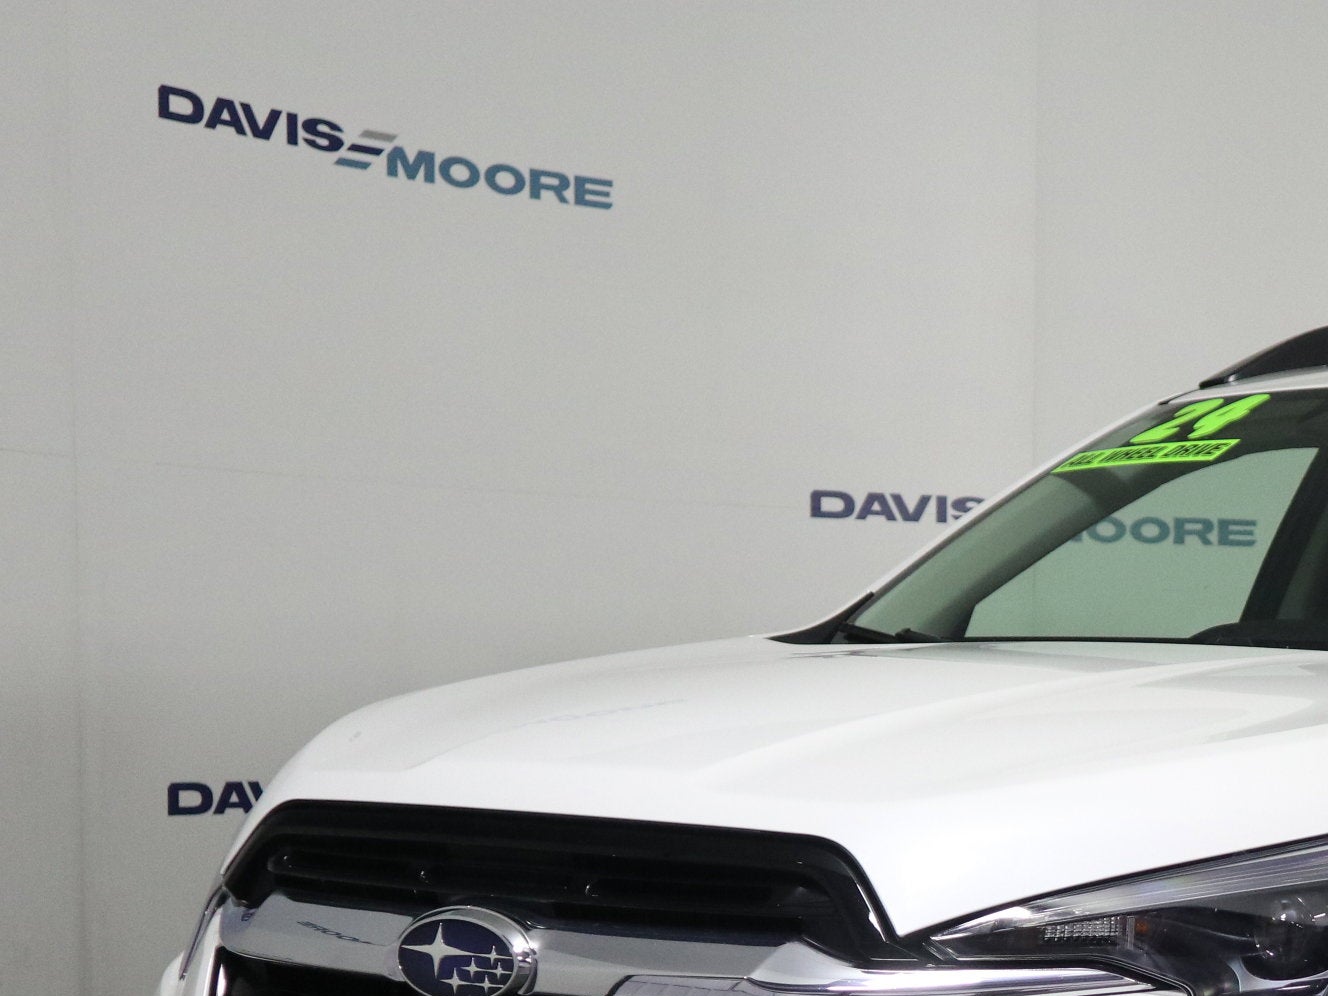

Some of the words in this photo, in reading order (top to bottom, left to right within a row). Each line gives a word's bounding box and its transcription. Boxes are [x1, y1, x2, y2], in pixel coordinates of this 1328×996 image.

[158, 84, 344, 152] DAVIS
[386, 145, 614, 210] MOORE
[1161, 441, 1231, 458] DRIVE
[1072, 517, 1258, 547] OORE
